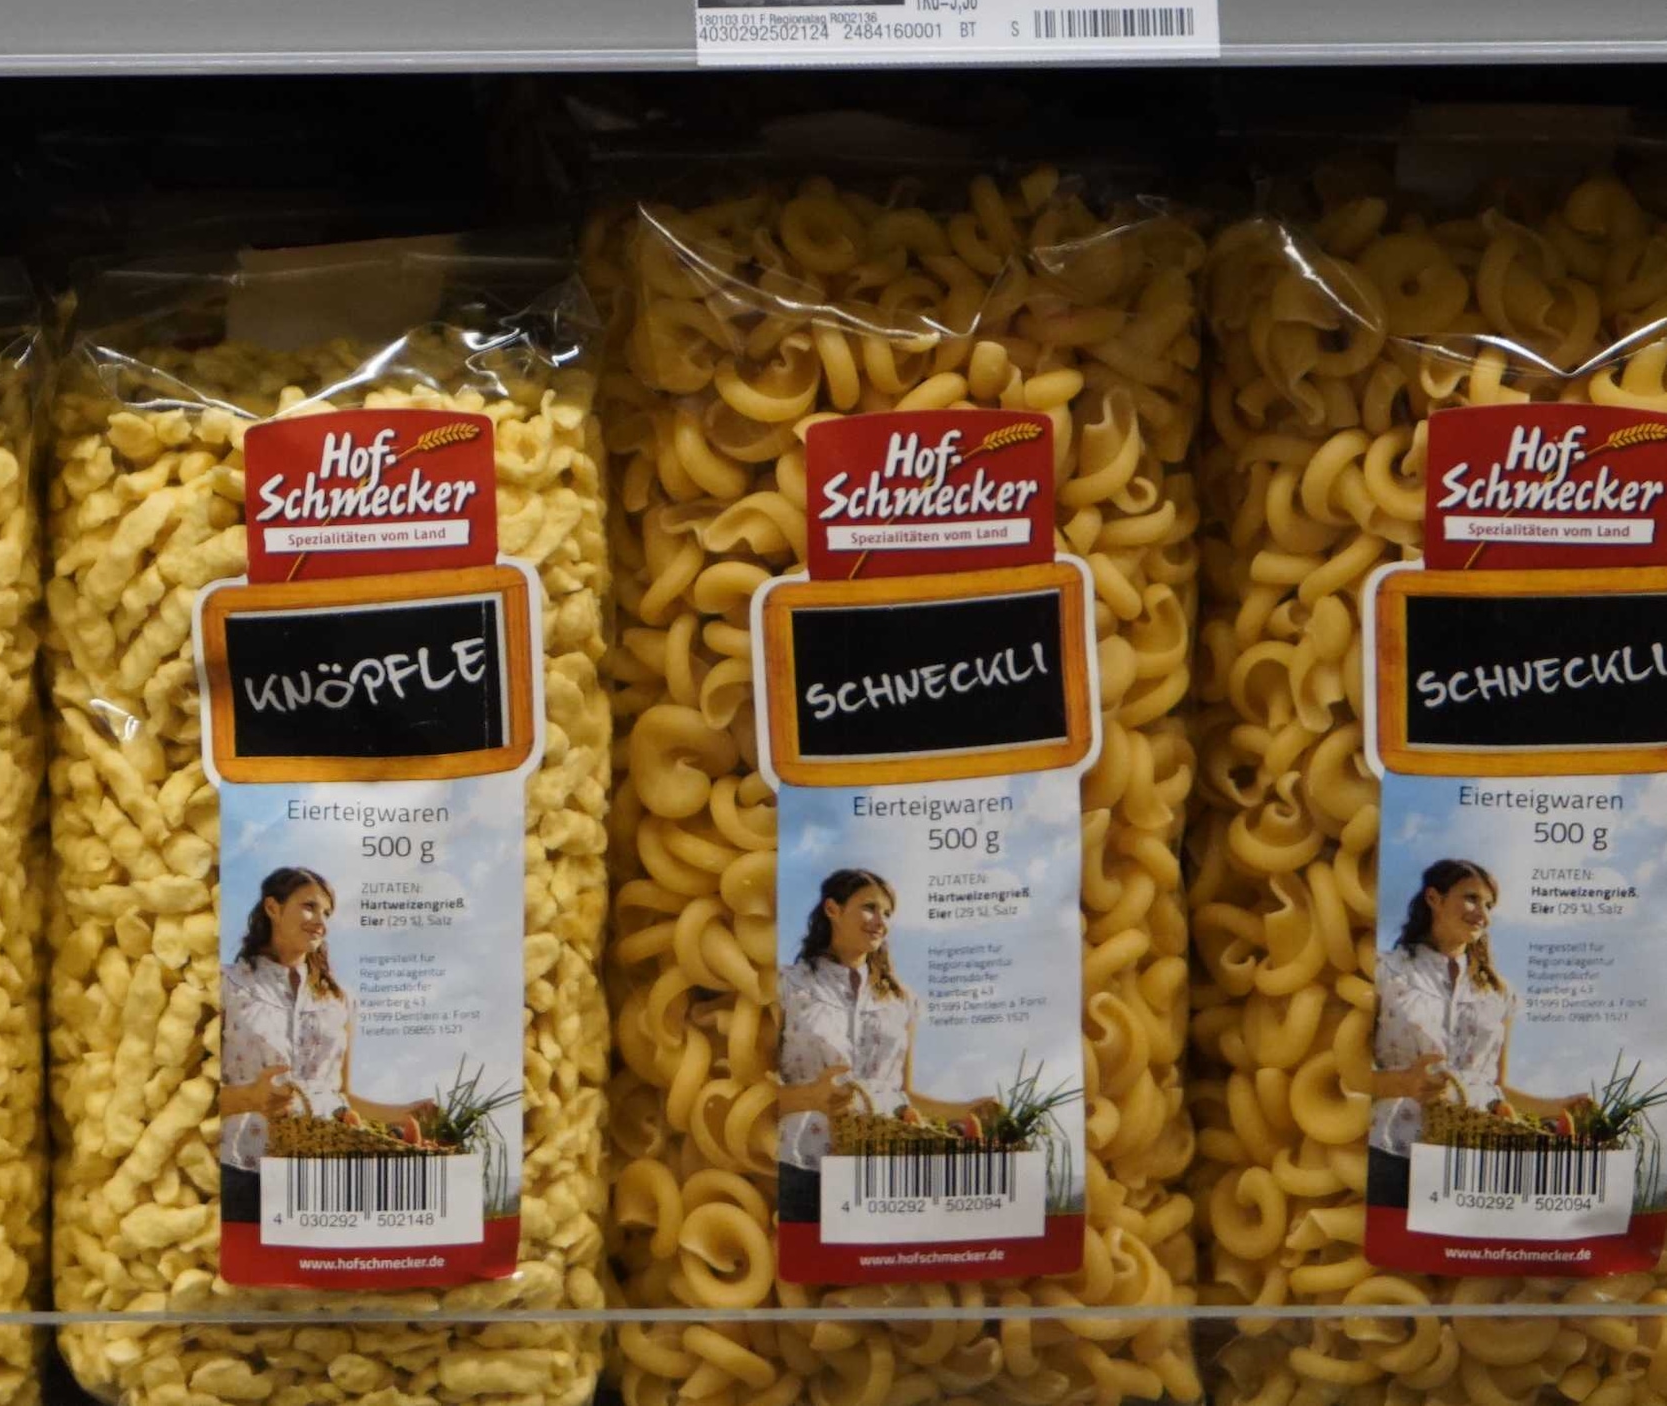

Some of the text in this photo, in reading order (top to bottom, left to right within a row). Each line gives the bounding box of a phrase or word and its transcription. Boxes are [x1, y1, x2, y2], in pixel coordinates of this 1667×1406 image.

[698, 21, 1019, 41] 4030292502124 2484160001 BT S
[320, 429, 395, 489] Hof-
[885, 430, 963, 491] Hof-
[1506, 425, 1586, 488] Hof-
[256, 469, 477, 522] Schmecker
[819, 469, 1038, 520] Schmecker
[1437, 464, 1664, 512] Schmecker
[288, 527, 446, 547] Spezialitäten vom Land
[1468, 523, 1630, 539] Spezialitäten vom Land
[244, 637, 486, 713] KNÖPFLE
[806, 642, 1049, 721] SCHNECKLI
[1416, 642, 1667, 709] SCHNECKLI
[288, 800, 449, 827] Eierteigwaren
[854, 795, 1014, 821] Eierteigwaren
[1459, 786, 1623, 813] Eierteigwaren
[362, 836, 435, 863] 500 g
[1534, 822, 1608, 851] 500 g
[299, 1256, 445, 1270] www.hofschmecker.de
[859, 1249, 1004, 1267] www.hofschmecker.de
[1445, 1247, 1592, 1261] www.hofschmecker.de
